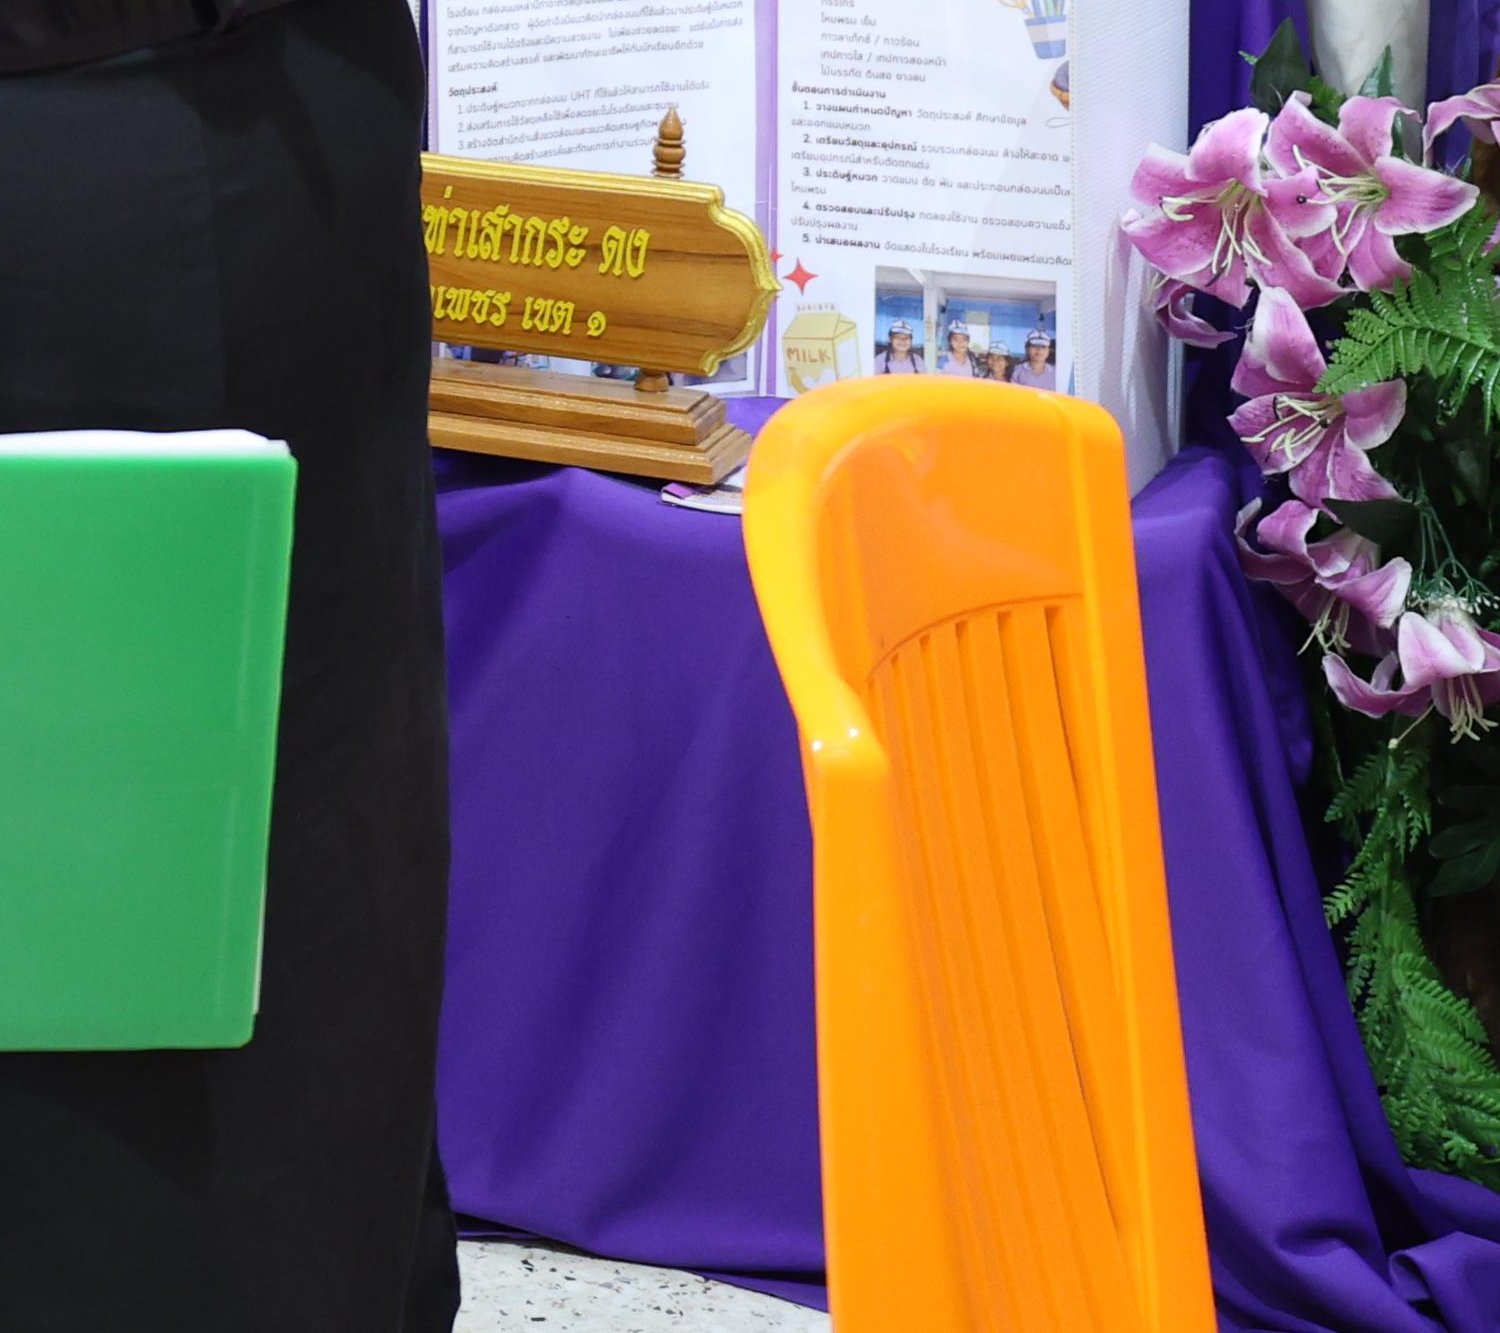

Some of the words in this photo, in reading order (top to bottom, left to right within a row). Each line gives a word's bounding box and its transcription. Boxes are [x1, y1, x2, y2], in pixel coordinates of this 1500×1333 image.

[570, 88, 591, 102] UHT
[597, 225, 650, 279] ดง
[430, 284, 512, 327] เพชร
[520, 295, 576, 336] เขต
[585, 310, 608, 338] ๑
[786, 346, 831, 364] MILK
